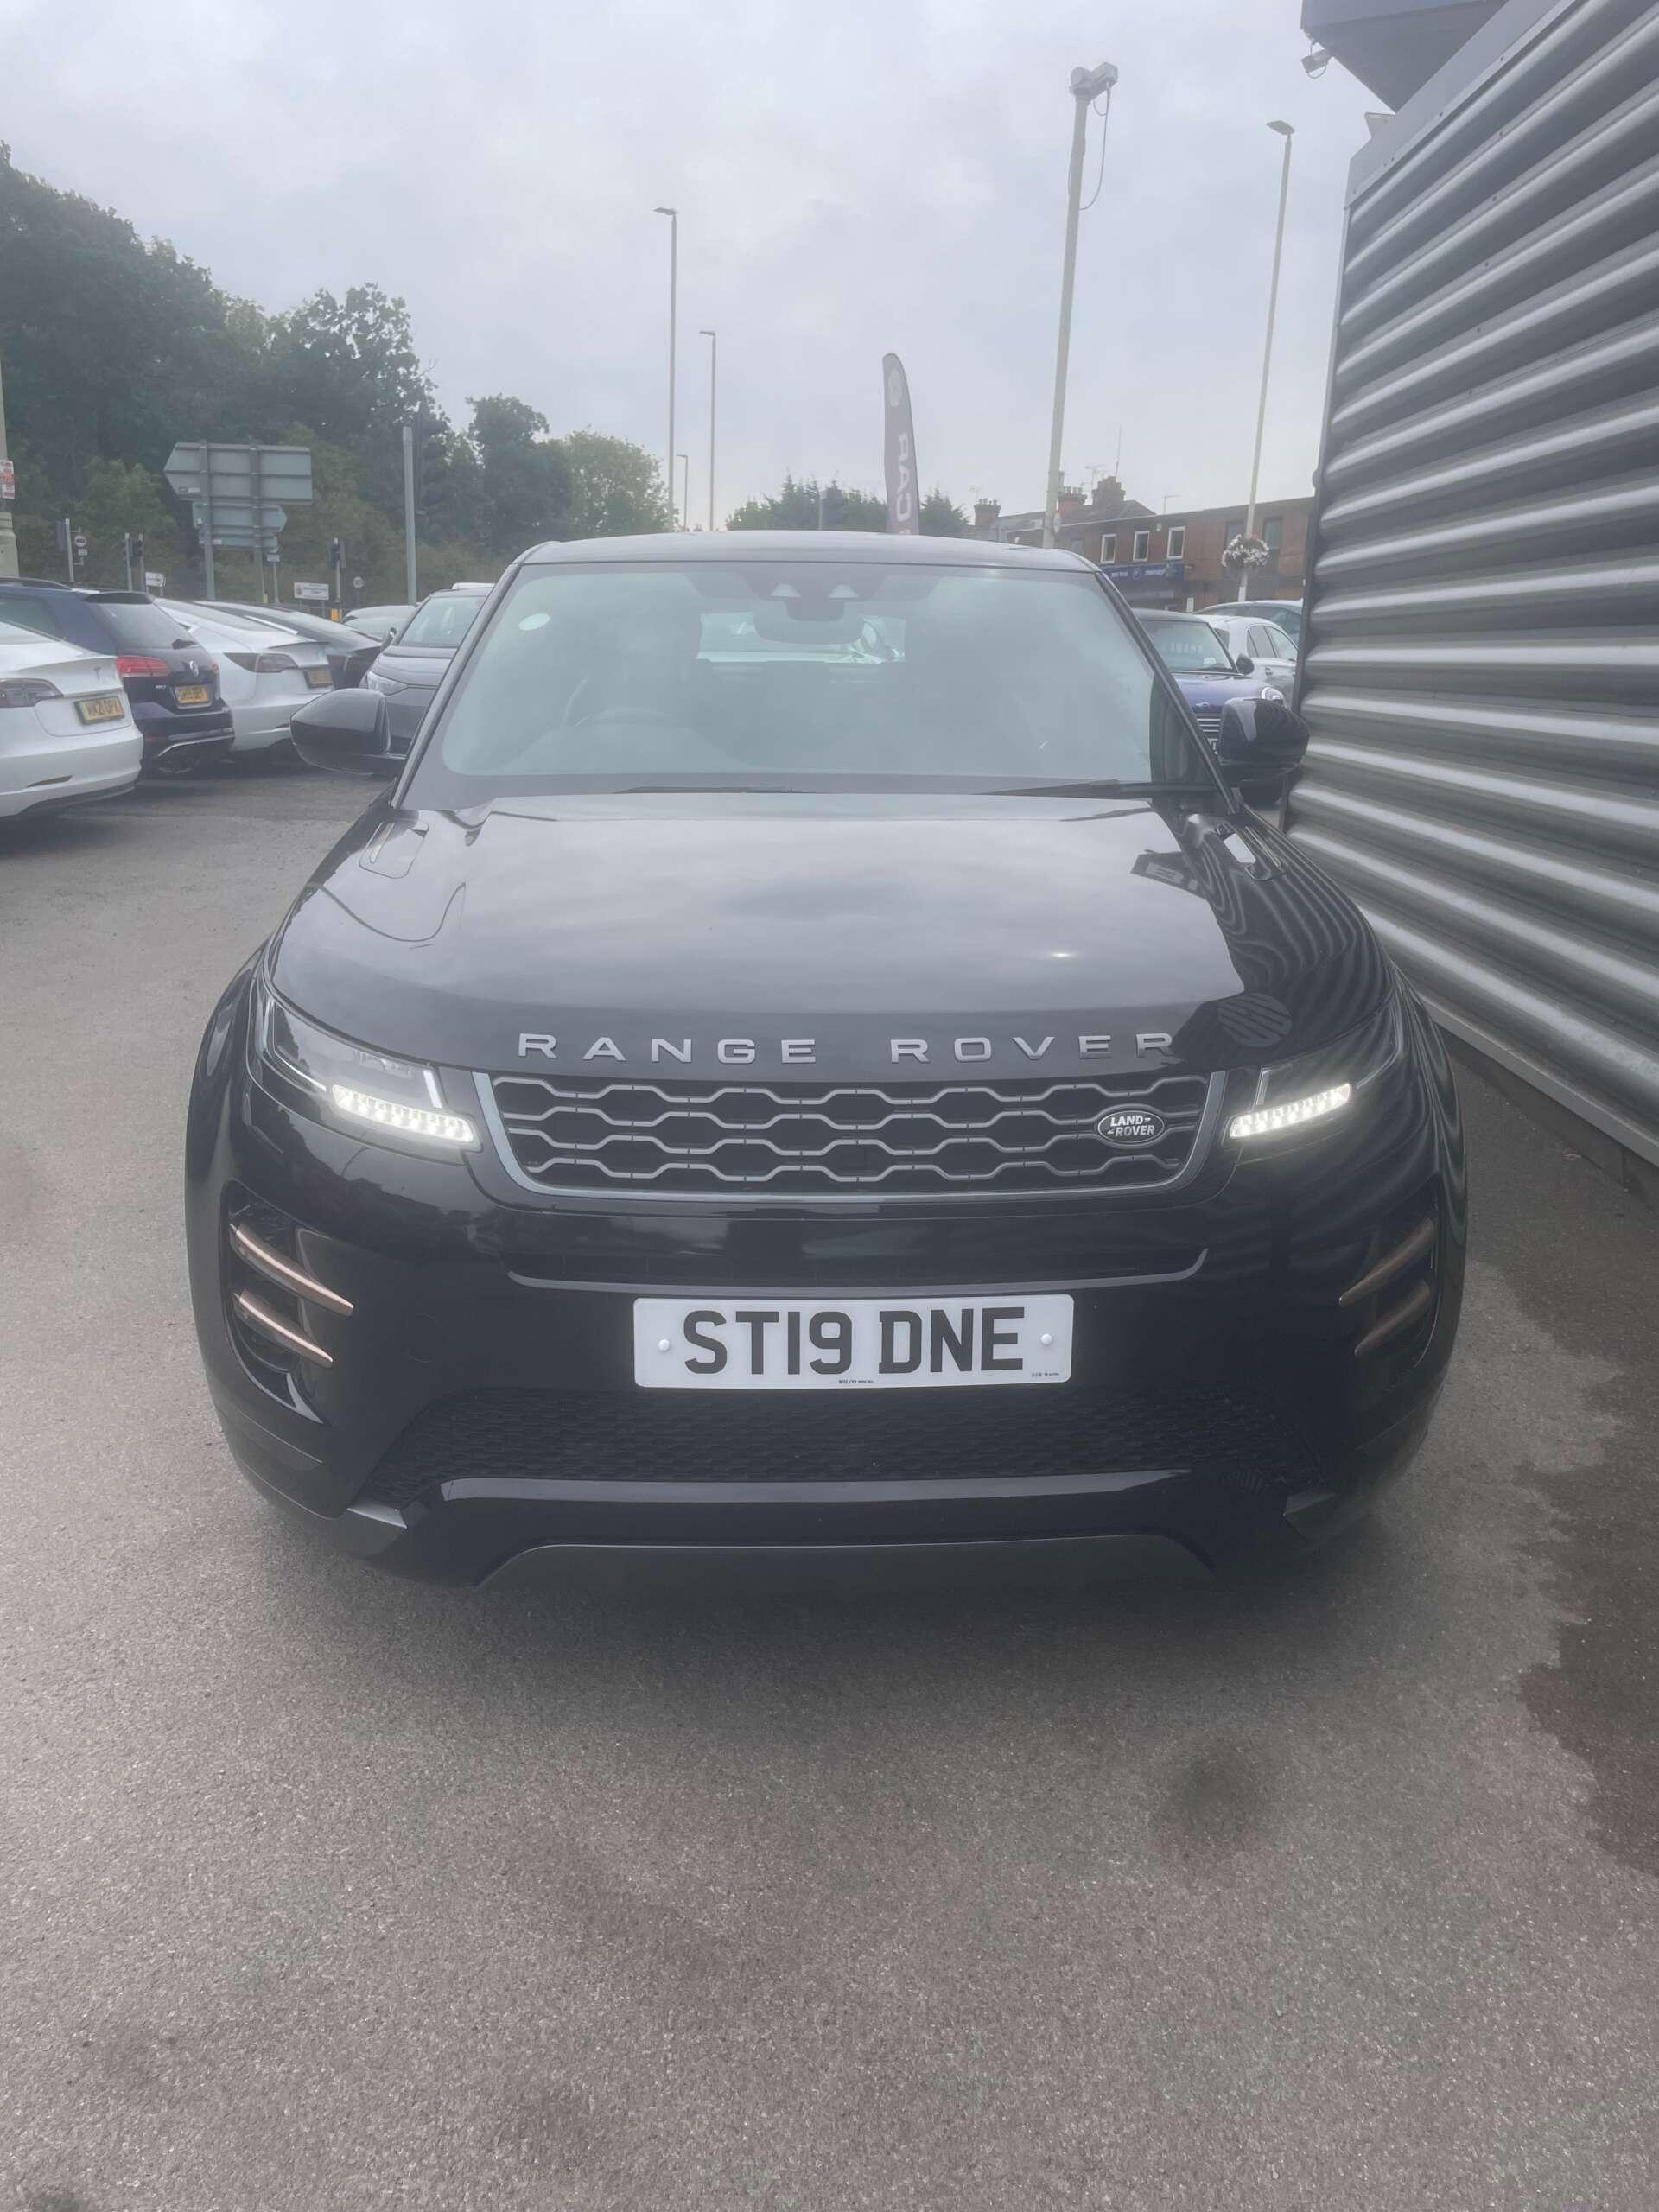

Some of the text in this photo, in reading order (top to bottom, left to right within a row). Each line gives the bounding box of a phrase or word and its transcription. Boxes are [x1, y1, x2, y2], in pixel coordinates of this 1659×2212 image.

[518, 1032, 1175, 1065] RANGE ROVER
[1109, 1115, 1144, 1127] LAND
[1115, 1124, 1155, 1137] ROVER
[683, 1306, 1025, 1375] ST19 DNE
